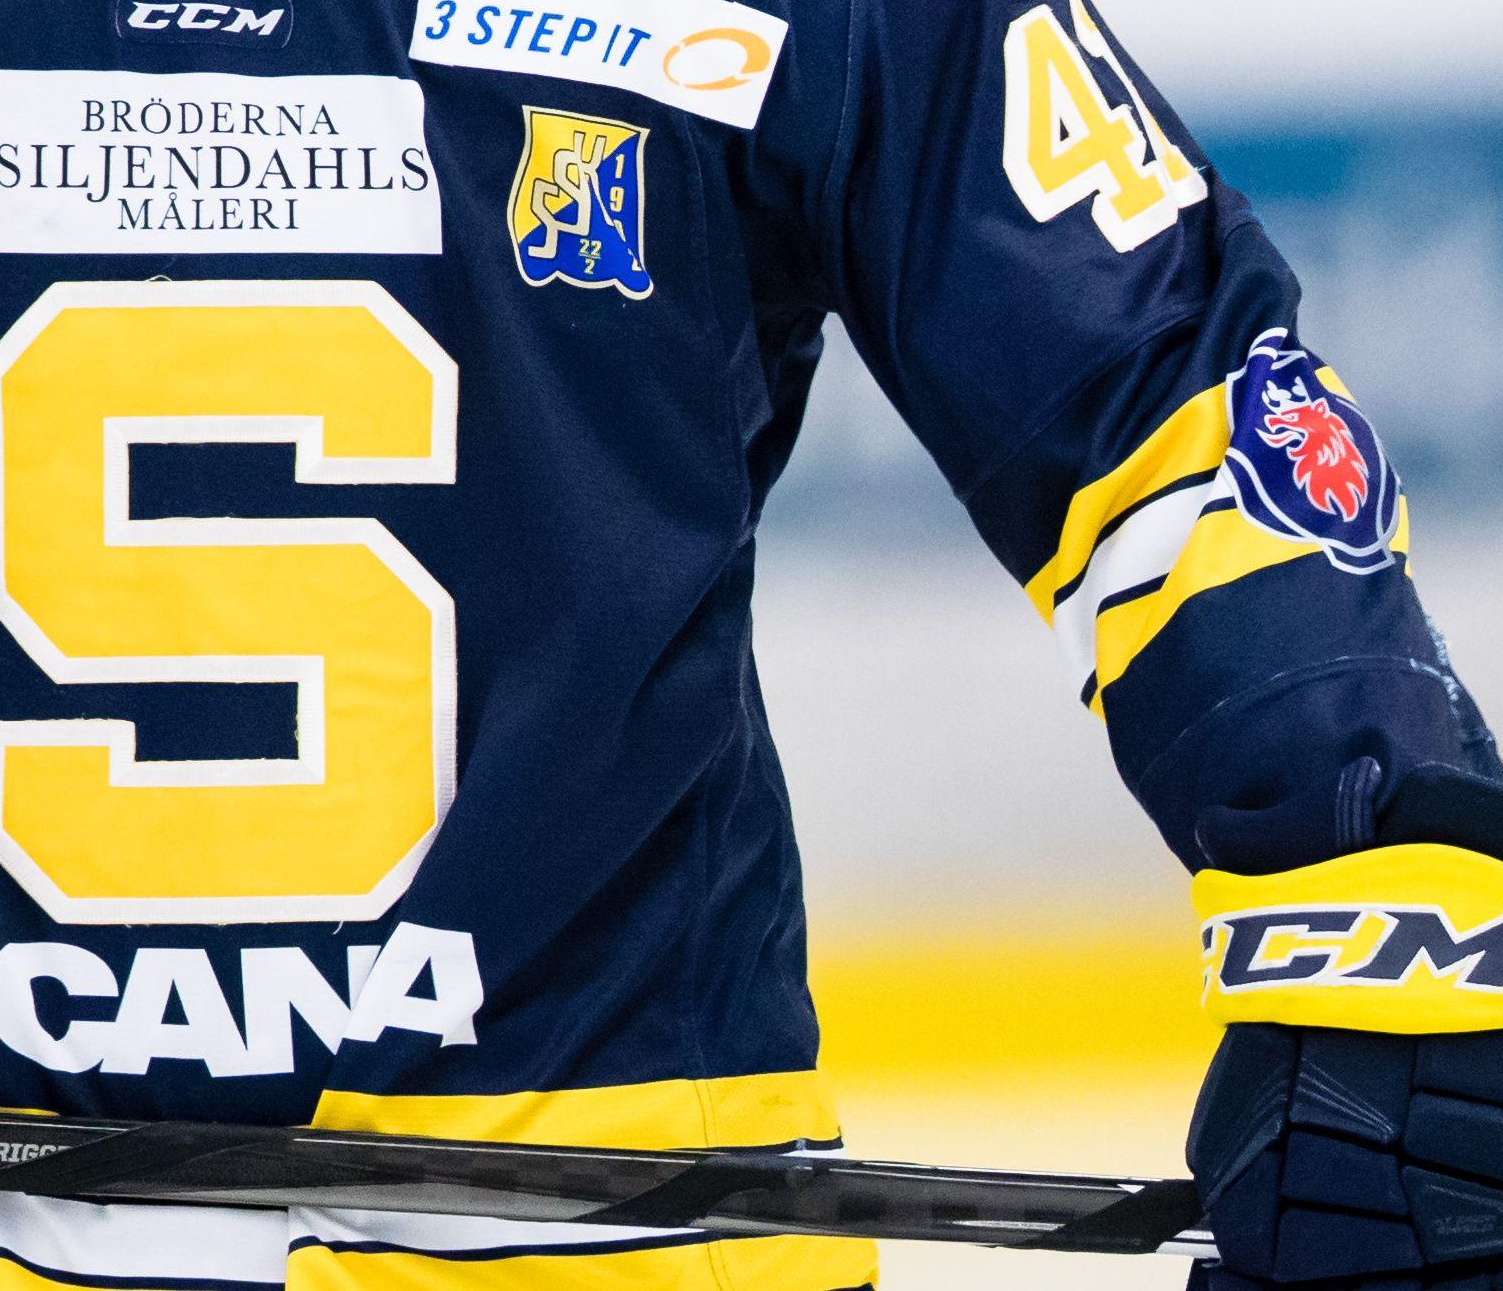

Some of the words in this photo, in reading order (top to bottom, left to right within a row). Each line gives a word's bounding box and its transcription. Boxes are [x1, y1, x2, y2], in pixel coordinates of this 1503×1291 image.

[128, 1, 285, 36] CCM
[425, 0, 457, 40] 3
[82, 99, 339, 136] BRÖDERNA
[117, 193, 298, 230] MÅLERI
